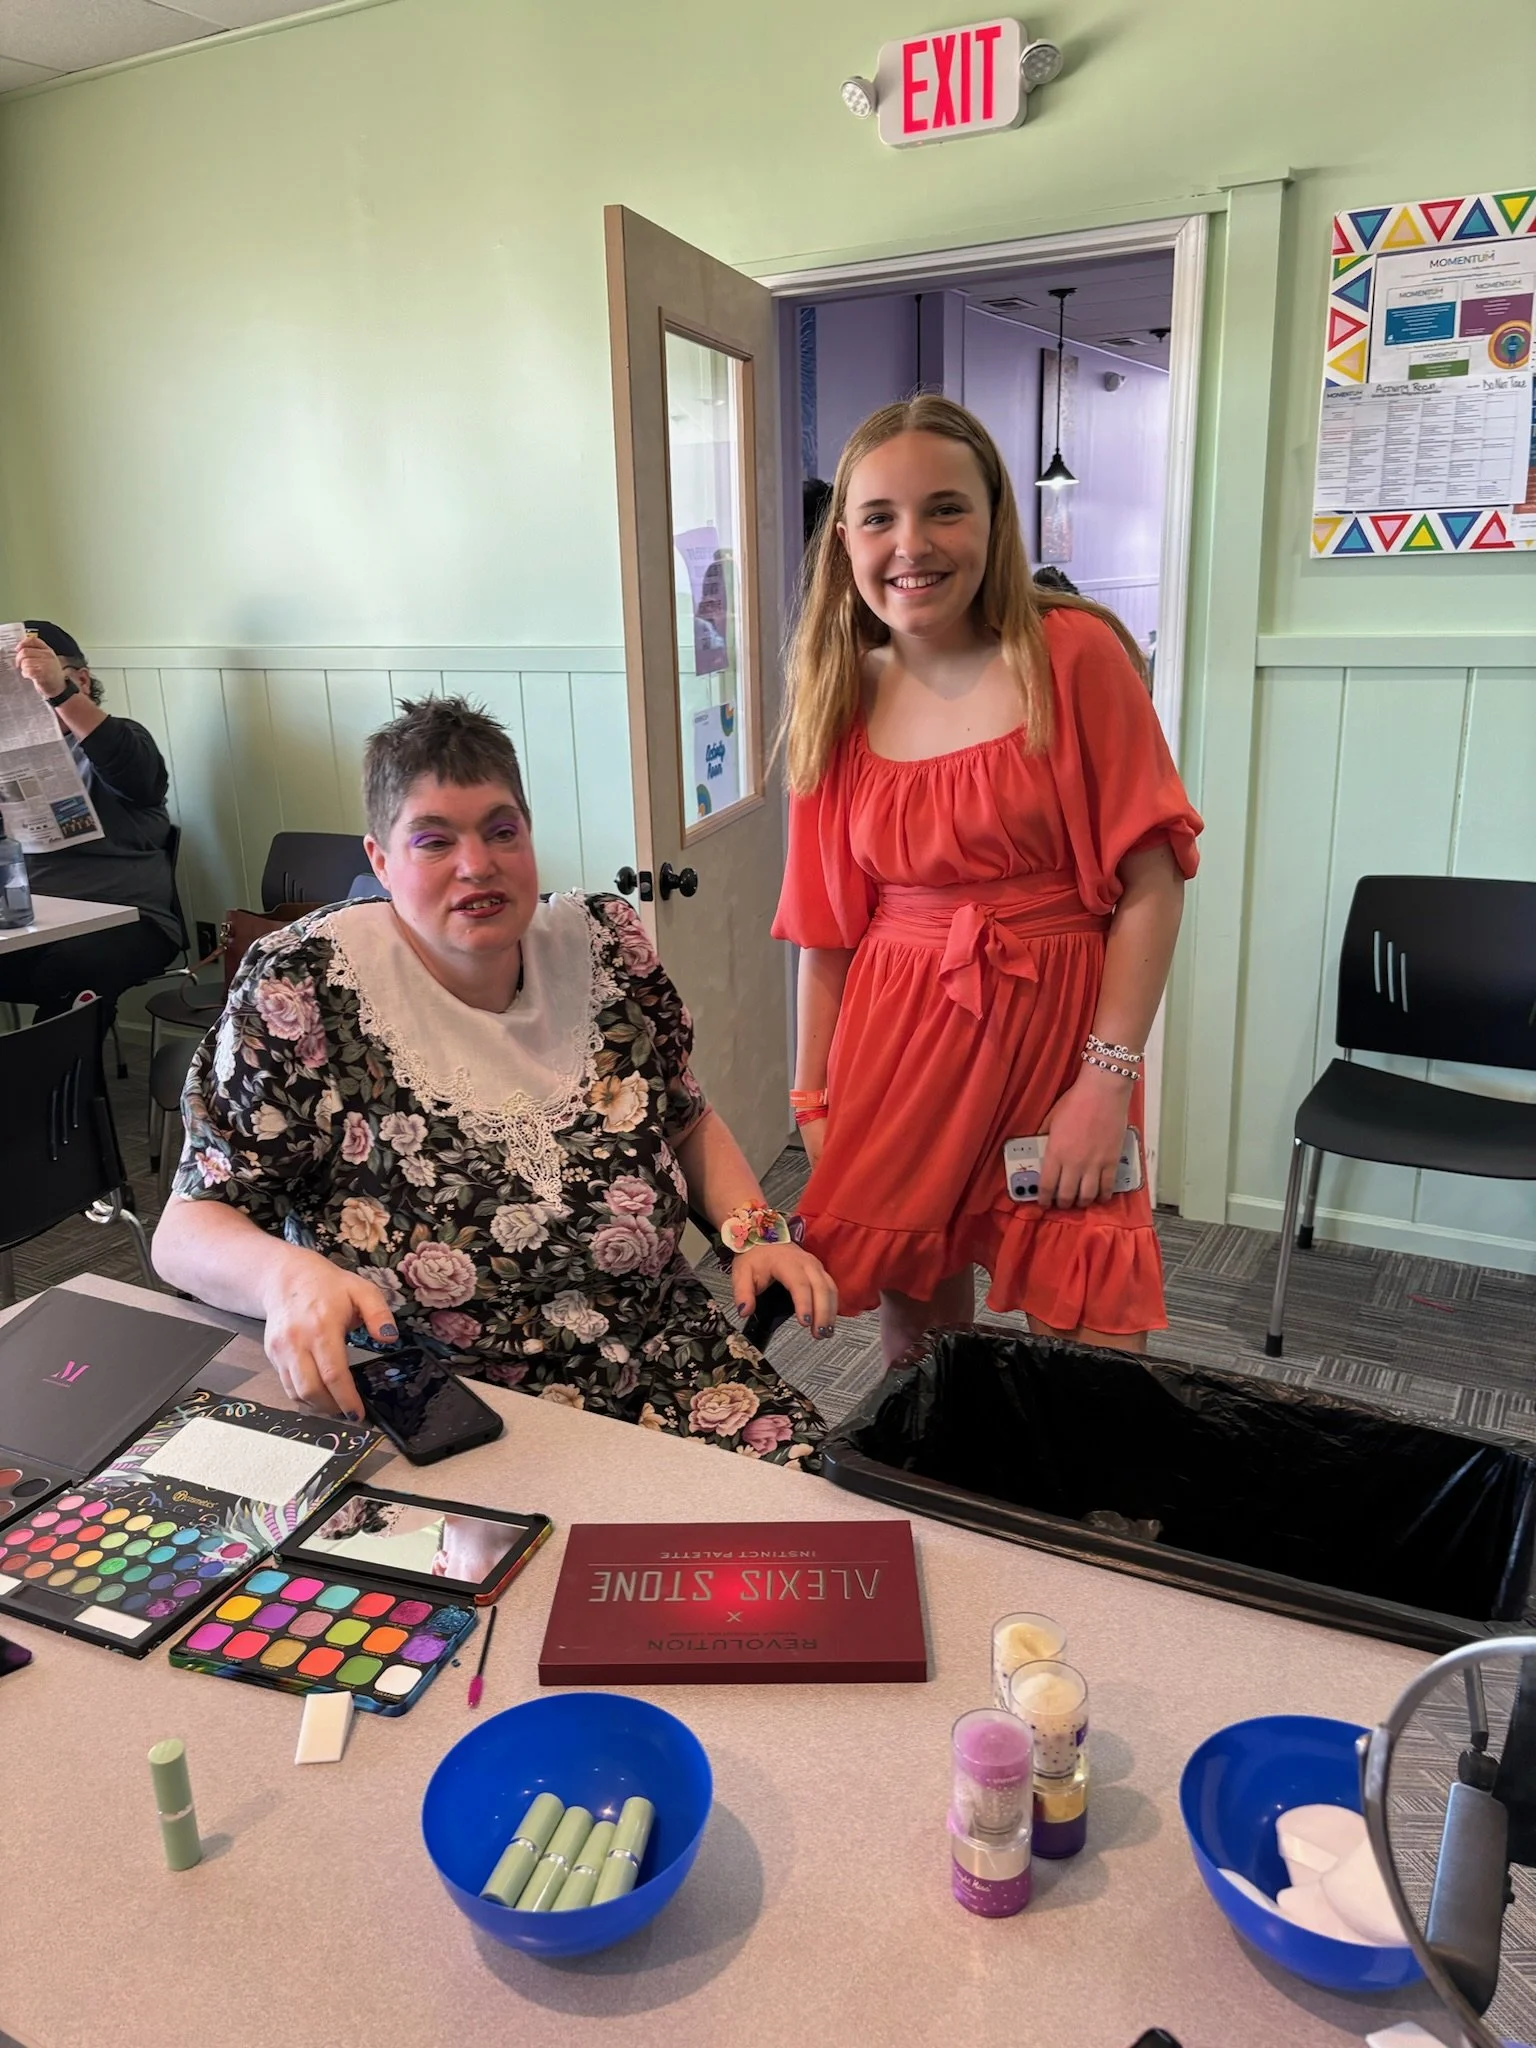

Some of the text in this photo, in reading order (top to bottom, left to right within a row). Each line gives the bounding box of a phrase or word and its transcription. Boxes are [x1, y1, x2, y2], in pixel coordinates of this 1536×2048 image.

[902, 25, 1002, 135] EXIT
[1429, 251, 1496, 269] MOMENTUM
[660, 1550, 816, 1559] INSTINCT PALETTE
[588, 1569, 880, 1602] ALEXIS STONE
[648, 1639, 818, 1650] REVOLUTION
